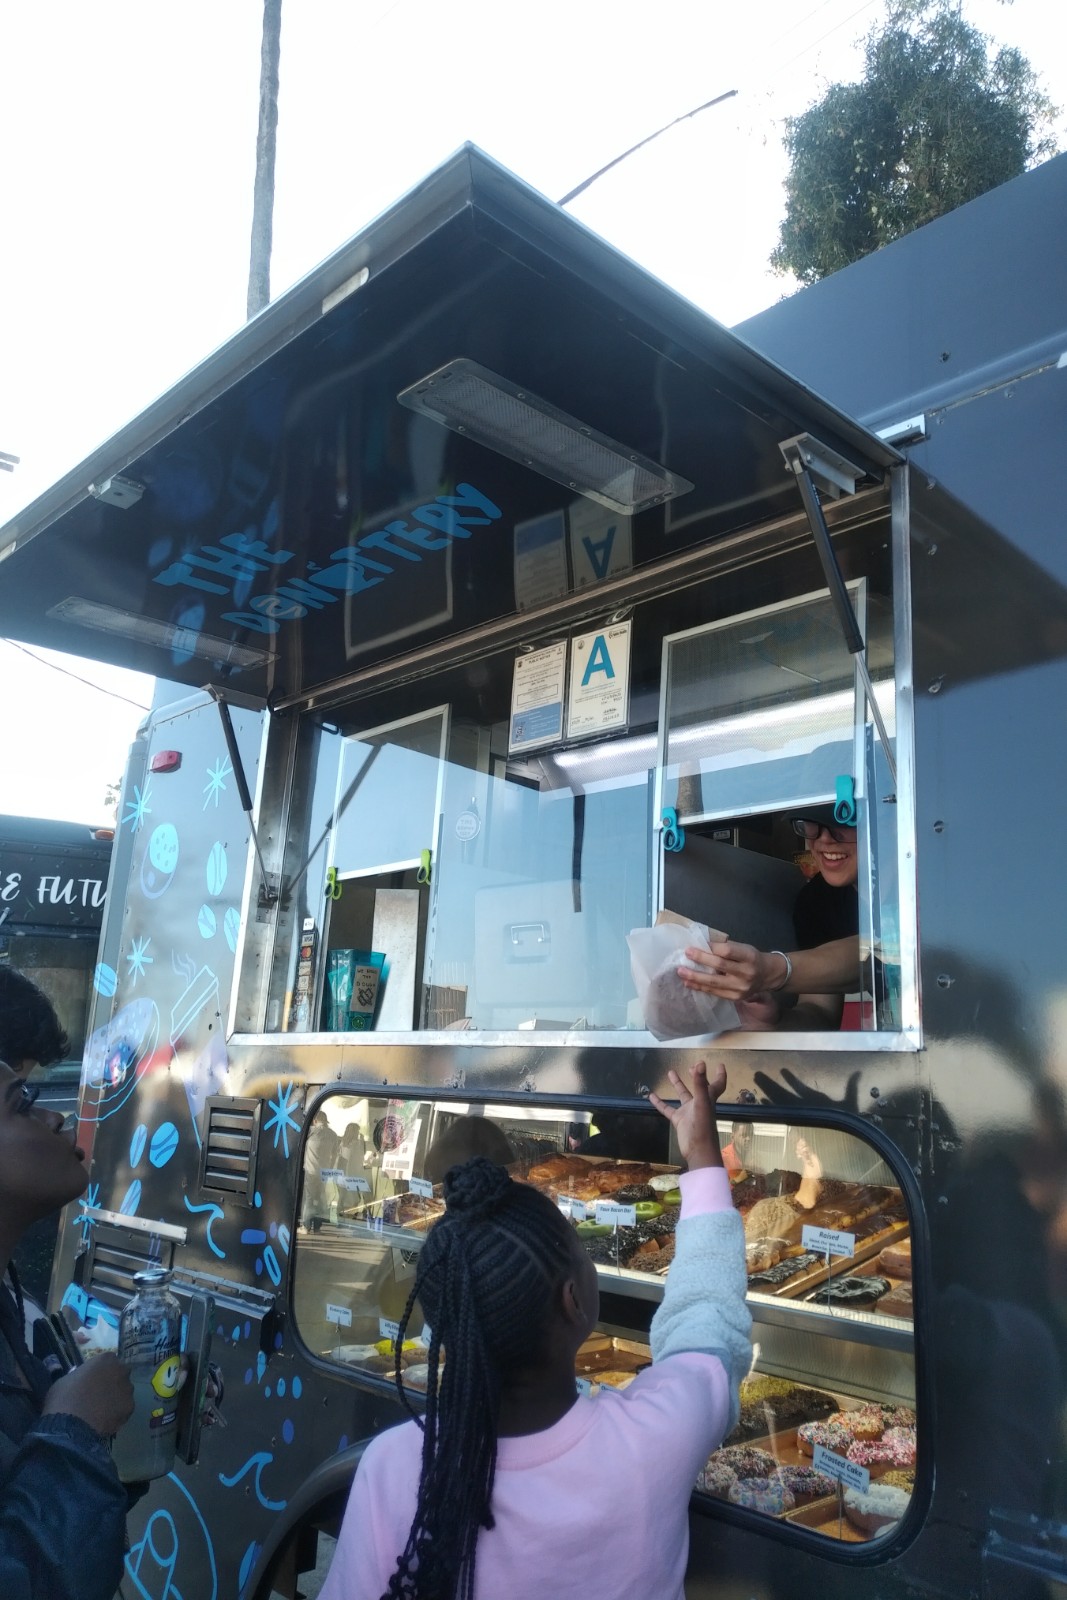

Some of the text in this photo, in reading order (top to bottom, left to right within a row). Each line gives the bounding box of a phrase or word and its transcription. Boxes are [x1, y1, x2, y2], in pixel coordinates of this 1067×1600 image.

[152, 531, 297, 596] THE
[580, 634, 616, 687] A
[819, 1231, 840, 1241] Raised
[821, 1451, 846, 1469] Frosted
[846, 1464, 863, 1477] Cake
